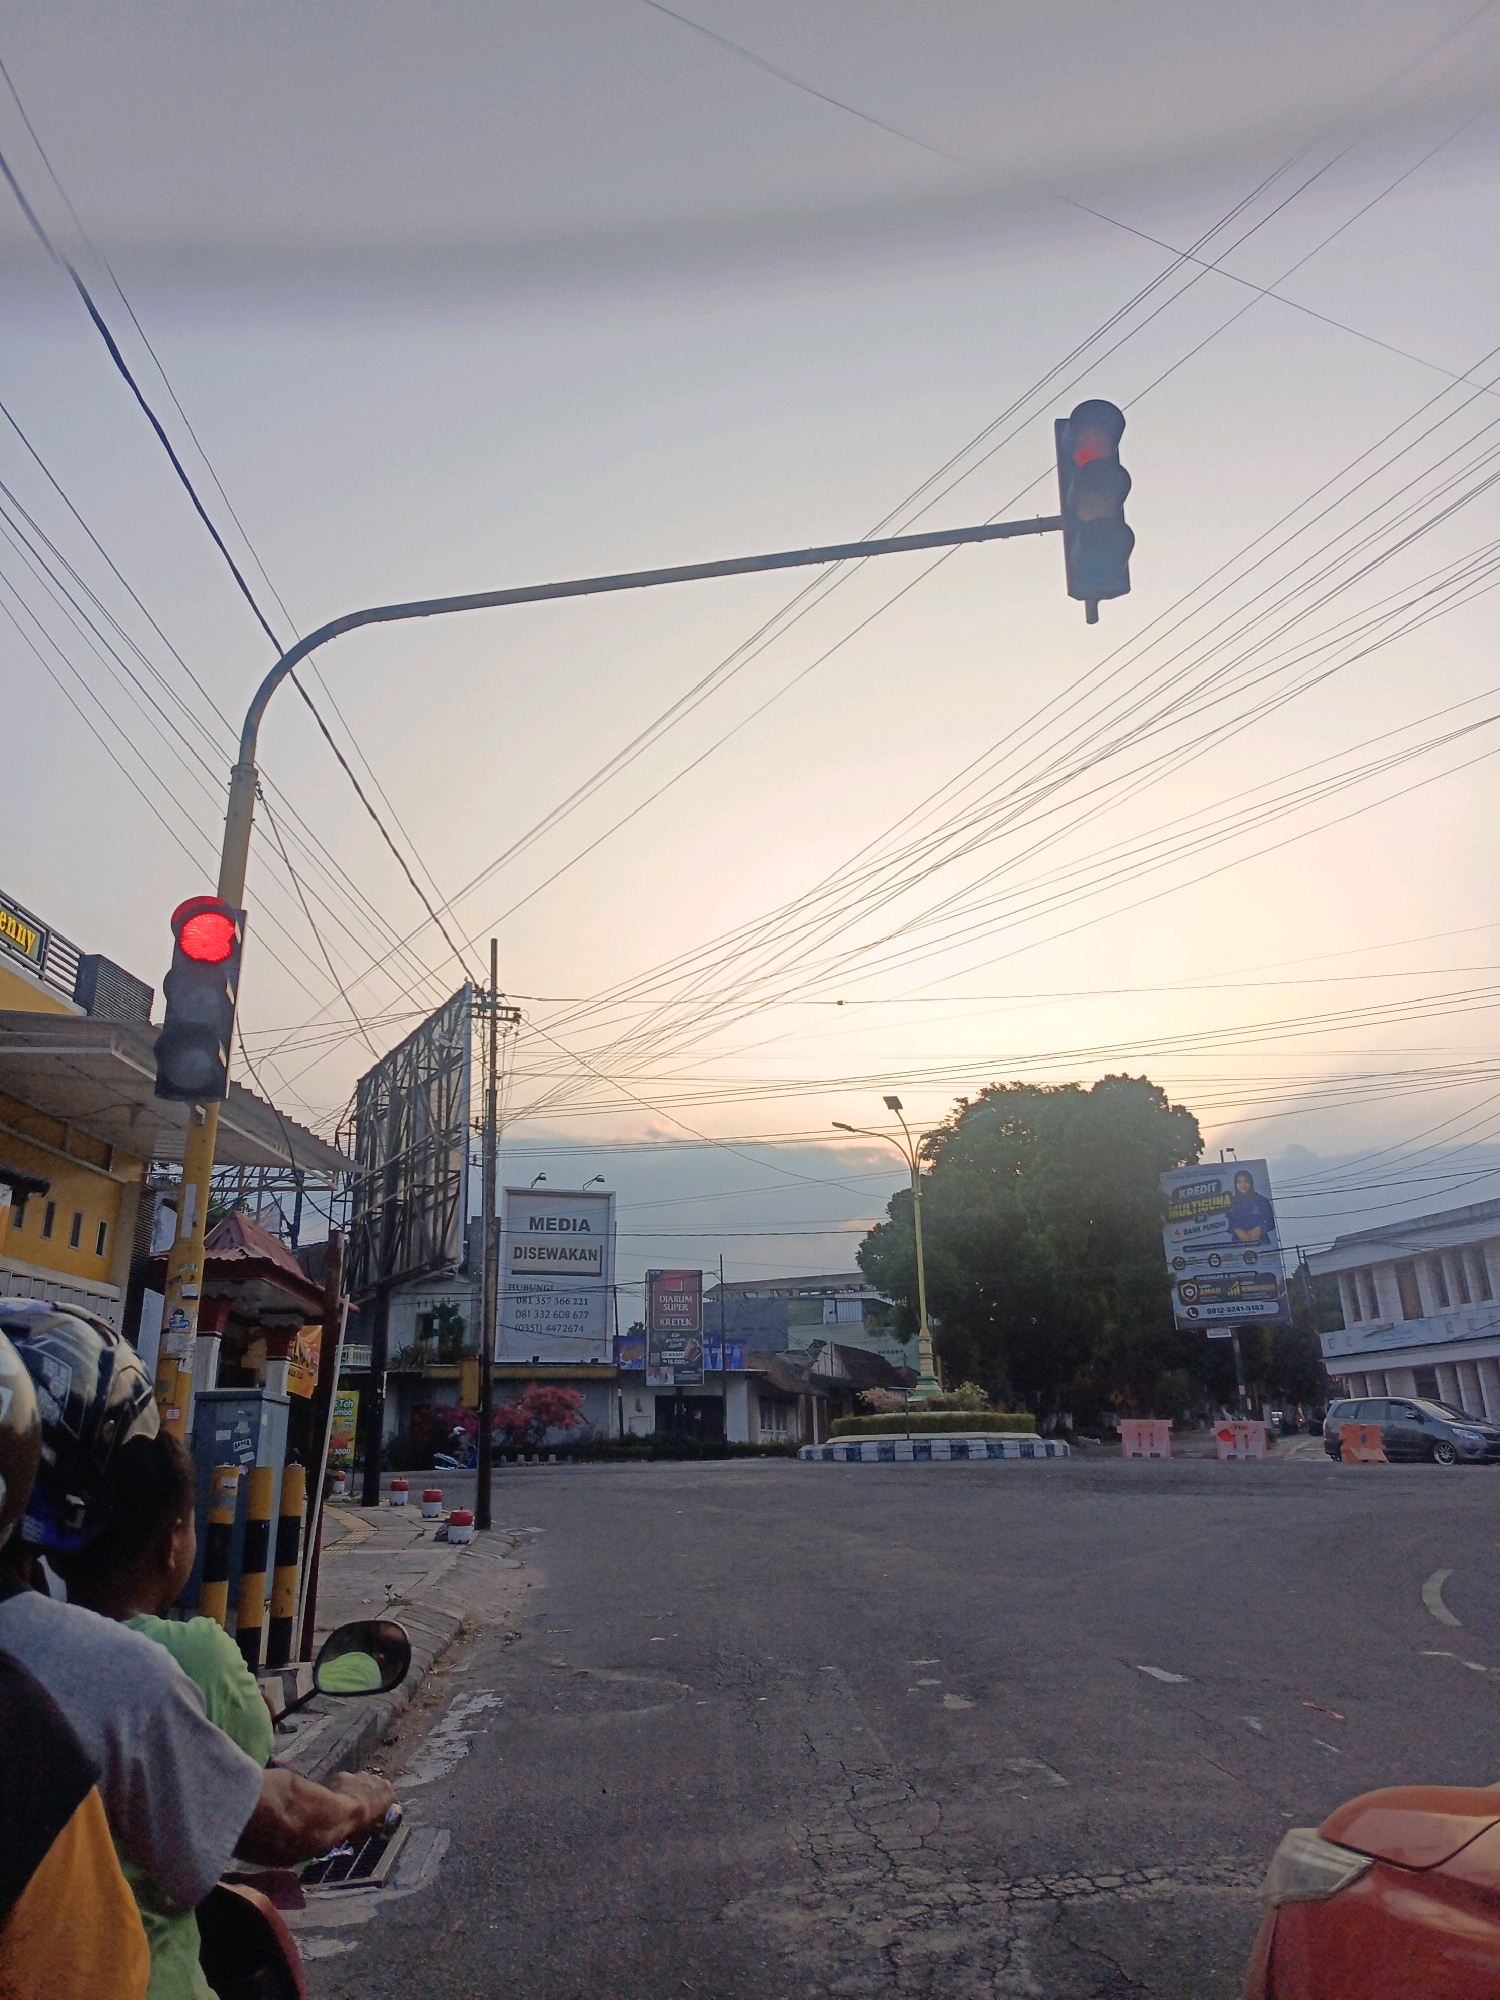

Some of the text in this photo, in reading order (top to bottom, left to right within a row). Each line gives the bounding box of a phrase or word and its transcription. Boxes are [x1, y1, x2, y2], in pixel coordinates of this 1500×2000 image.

[1178, 1182, 1217, 1199] KREDIT
[1168, 1194, 1231, 1219] MULTIGUNA
[529, 1216, 591, 1232] MEDIA
[1183, 1220, 1226, 1235] BANK PUNDHI
[513, 1246, 598, 1262] DISEWAKAN
[516, 1296, 532, 1304] 081
[554, 1297, 570, 1305] 366
[573, 1298, 588, 1306] 221
[659, 1295, 692, 1304] DJARUM
[515, 1310, 589, 1319] 081 332 608 677
[659, 1318, 692, 1326] KRETEK
[515, 1324, 584, 1333] (0351) 4472674
[340, 1399, 354, 1408] Teh
